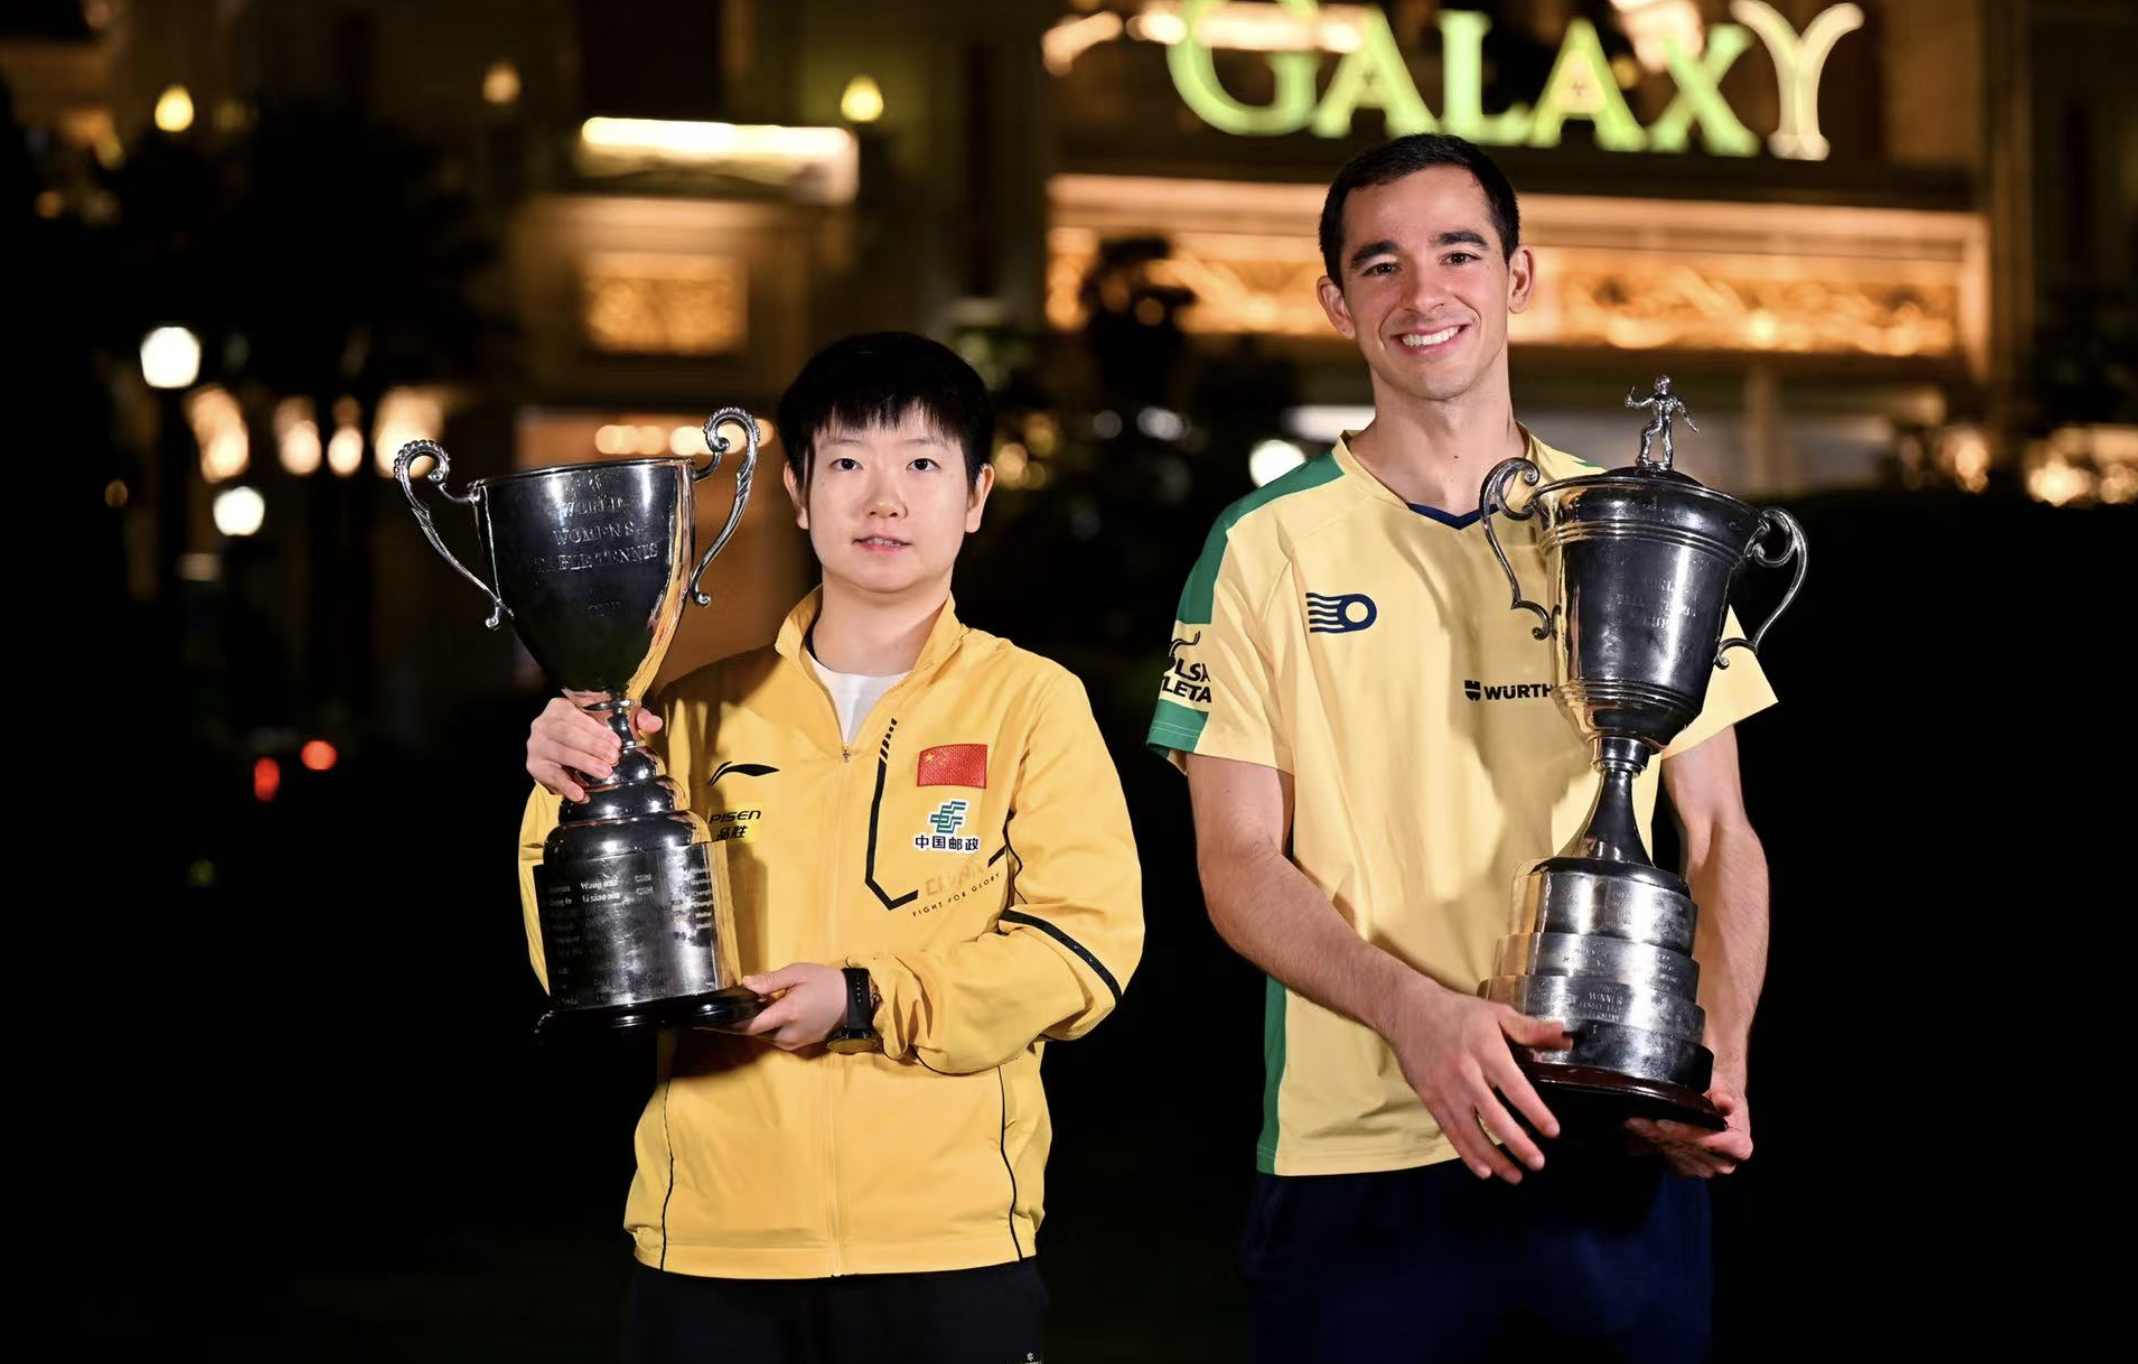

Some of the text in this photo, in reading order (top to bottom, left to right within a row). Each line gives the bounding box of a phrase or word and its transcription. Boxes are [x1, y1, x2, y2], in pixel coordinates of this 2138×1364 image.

[1166, 0, 1864, 161] GALAXY
[1171, 656, 1211, 683] LSA
[709, 810, 761, 825] PISEN
[915, 835, 979, 851] 中国邮政
[912, 872, 1000, 917] FIGHT FOR GLORY
